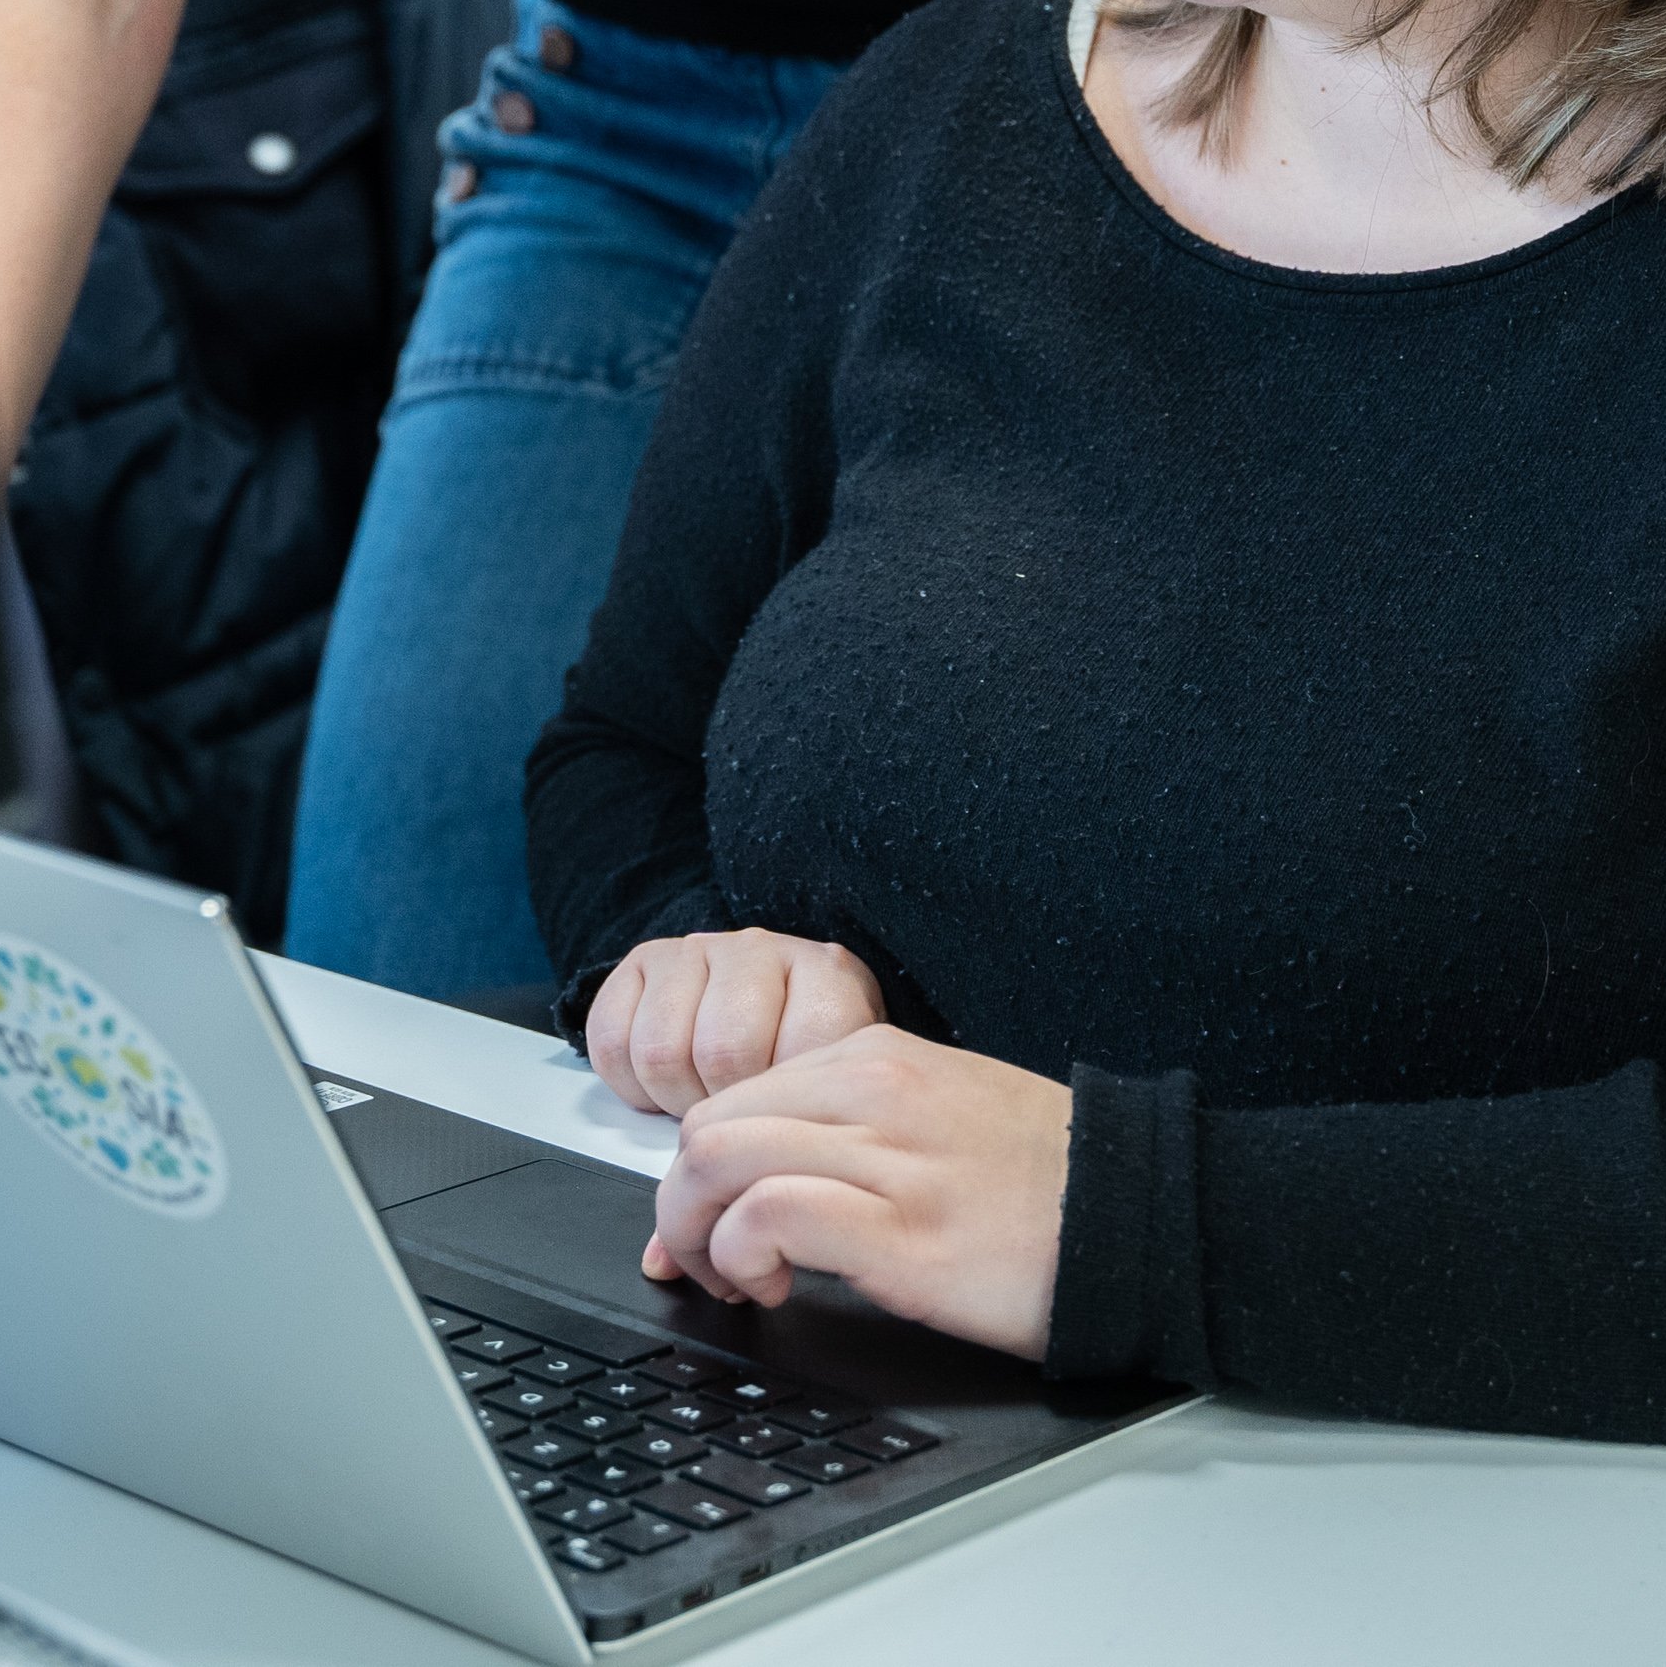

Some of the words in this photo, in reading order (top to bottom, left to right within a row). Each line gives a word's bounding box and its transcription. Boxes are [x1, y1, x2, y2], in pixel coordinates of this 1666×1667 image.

[483, 1340, 504, 1350] V
[547, 1360, 569, 1372] C
[611, 1383, 636, 1396] X
[520, 1392, 544, 1406] D
[671, 1406, 701, 1421] W
[584, 1415, 608, 1429] S
